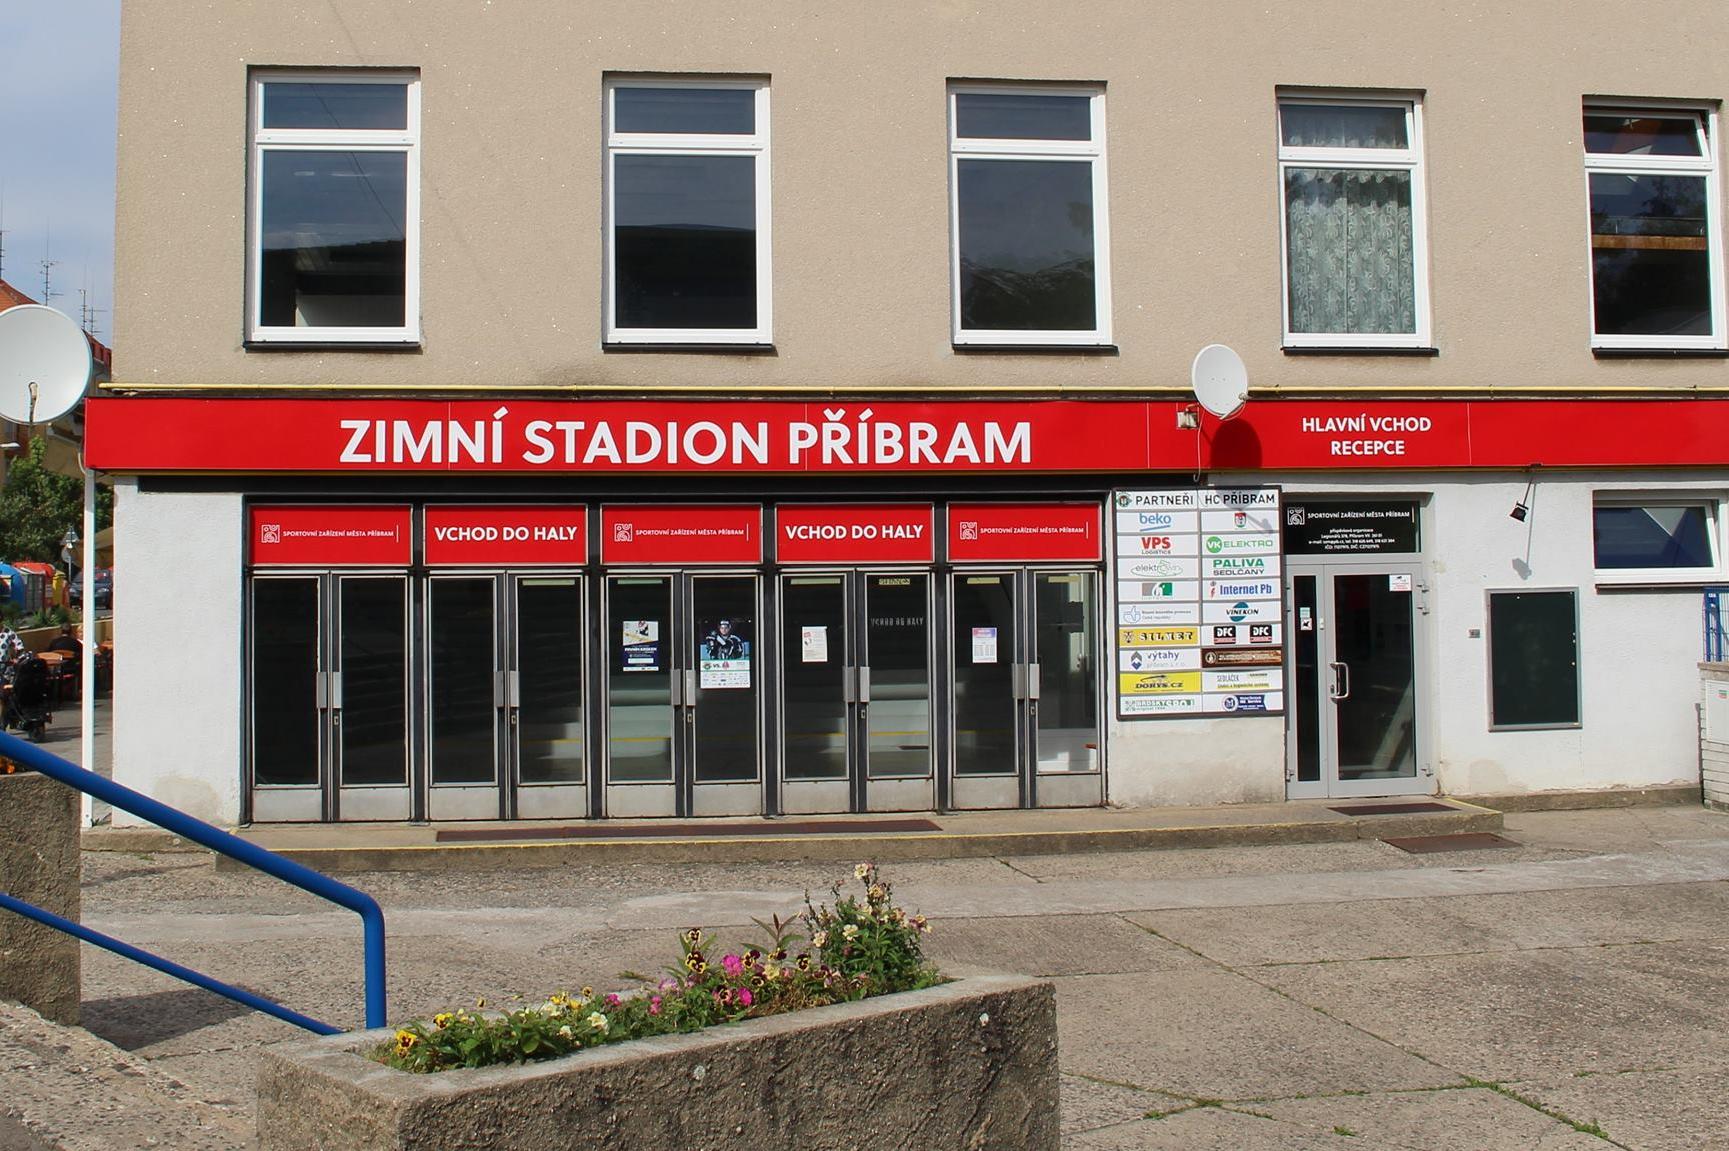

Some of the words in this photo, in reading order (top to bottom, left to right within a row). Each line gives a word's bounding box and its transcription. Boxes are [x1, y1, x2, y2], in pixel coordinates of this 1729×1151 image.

[1302, 413, 1367, 433] HLAVNÍ
[1369, 415, 1432, 432] VCHOD
[339, 406, 509, 464] ZIMNÍ
[522, 419, 768, 466] STADION
[789, 407, 1032, 464] PŘÍBRAM
[1330, 439, 1406, 456] RECEPCE
[1135, 492, 1194, 507] PARTNEŘI
[1204, 495, 1220, 505] HC
[1222, 491, 1275, 504] PŘÍBRAM
[1139, 513, 1172, 525] beko
[1385, 510, 1410, 518] PŘÍBRAM
[282, 529, 318, 537] SPORTOVNÍ
[319, 529, 344, 537] ZAŘÍZENÍ
[345, 529, 366, 537] MĚSTA
[367, 529, 394, 537] PŘÍBRAM
[434, 526, 499, 542] VCHOD
[502, 526, 530, 541] DO
[533, 525, 578, 541] HALY
[785, 525, 848, 540] VCHOD
[851, 525, 878, 539] DO
[881, 523, 924, 539] HALY
[1141, 536, 1172, 550] VPS
[1207, 541, 1222, 549] VK
[1223, 539, 1274, 548] ELEKTRO
[1213, 558, 1265, 568] PALIVA
[1213, 568, 1265, 577] SEDLČANY
[1219, 583, 1258, 596] Internet
[1260, 583, 1273, 595] Pb
[1225, 608, 1260, 616] VINEKON
[1139, 631, 1193, 641] SILMET
[1217, 627, 1233, 637] DFC
[1252, 626, 1269, 636] DFC
[1147, 651, 1180, 661] výtahy
